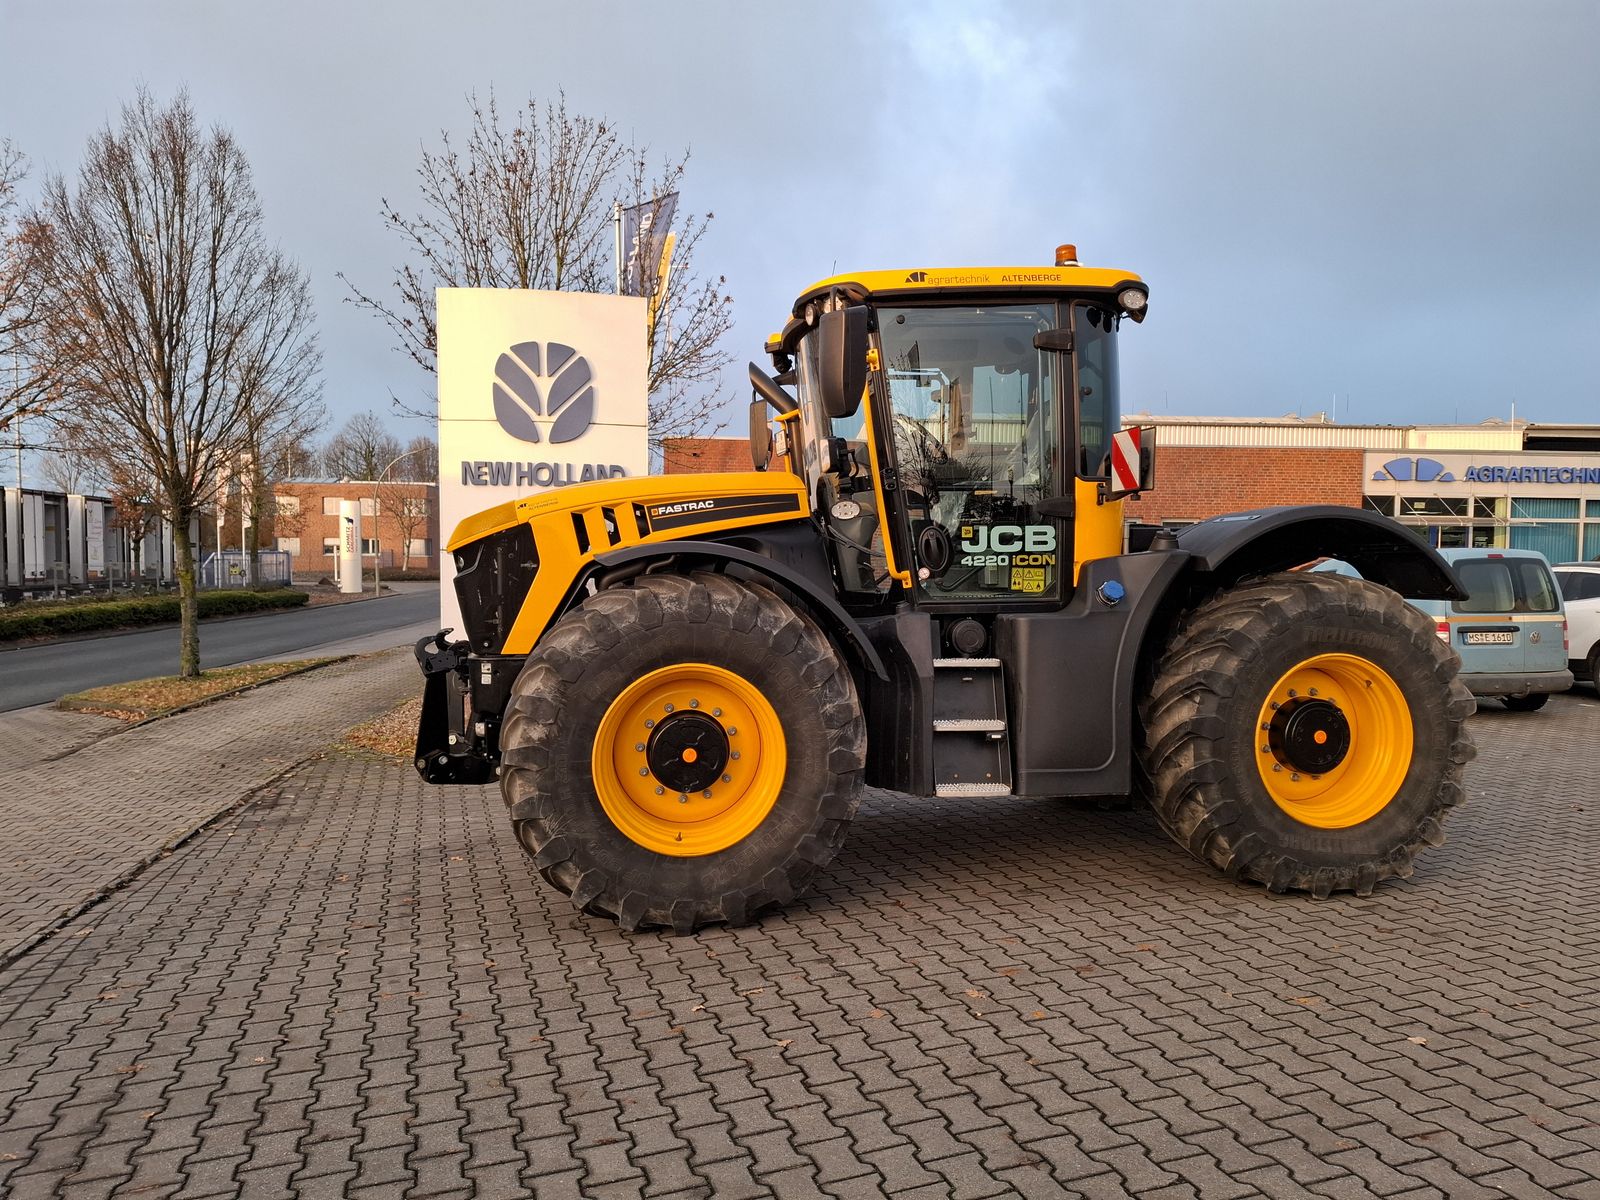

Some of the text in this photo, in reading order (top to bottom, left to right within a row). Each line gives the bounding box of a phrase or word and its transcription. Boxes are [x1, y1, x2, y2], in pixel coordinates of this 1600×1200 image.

[928, 274, 1062, 286] agrartechnik ALTENBERGE
[461, 461, 512, 487] NEW
[1464, 465, 1600, 485] AGRARTECHN
[658, 500, 715, 515] FASTRAC
[961, 525, 1057, 553] JCB
[960, 555, 1009, 567] 4220
